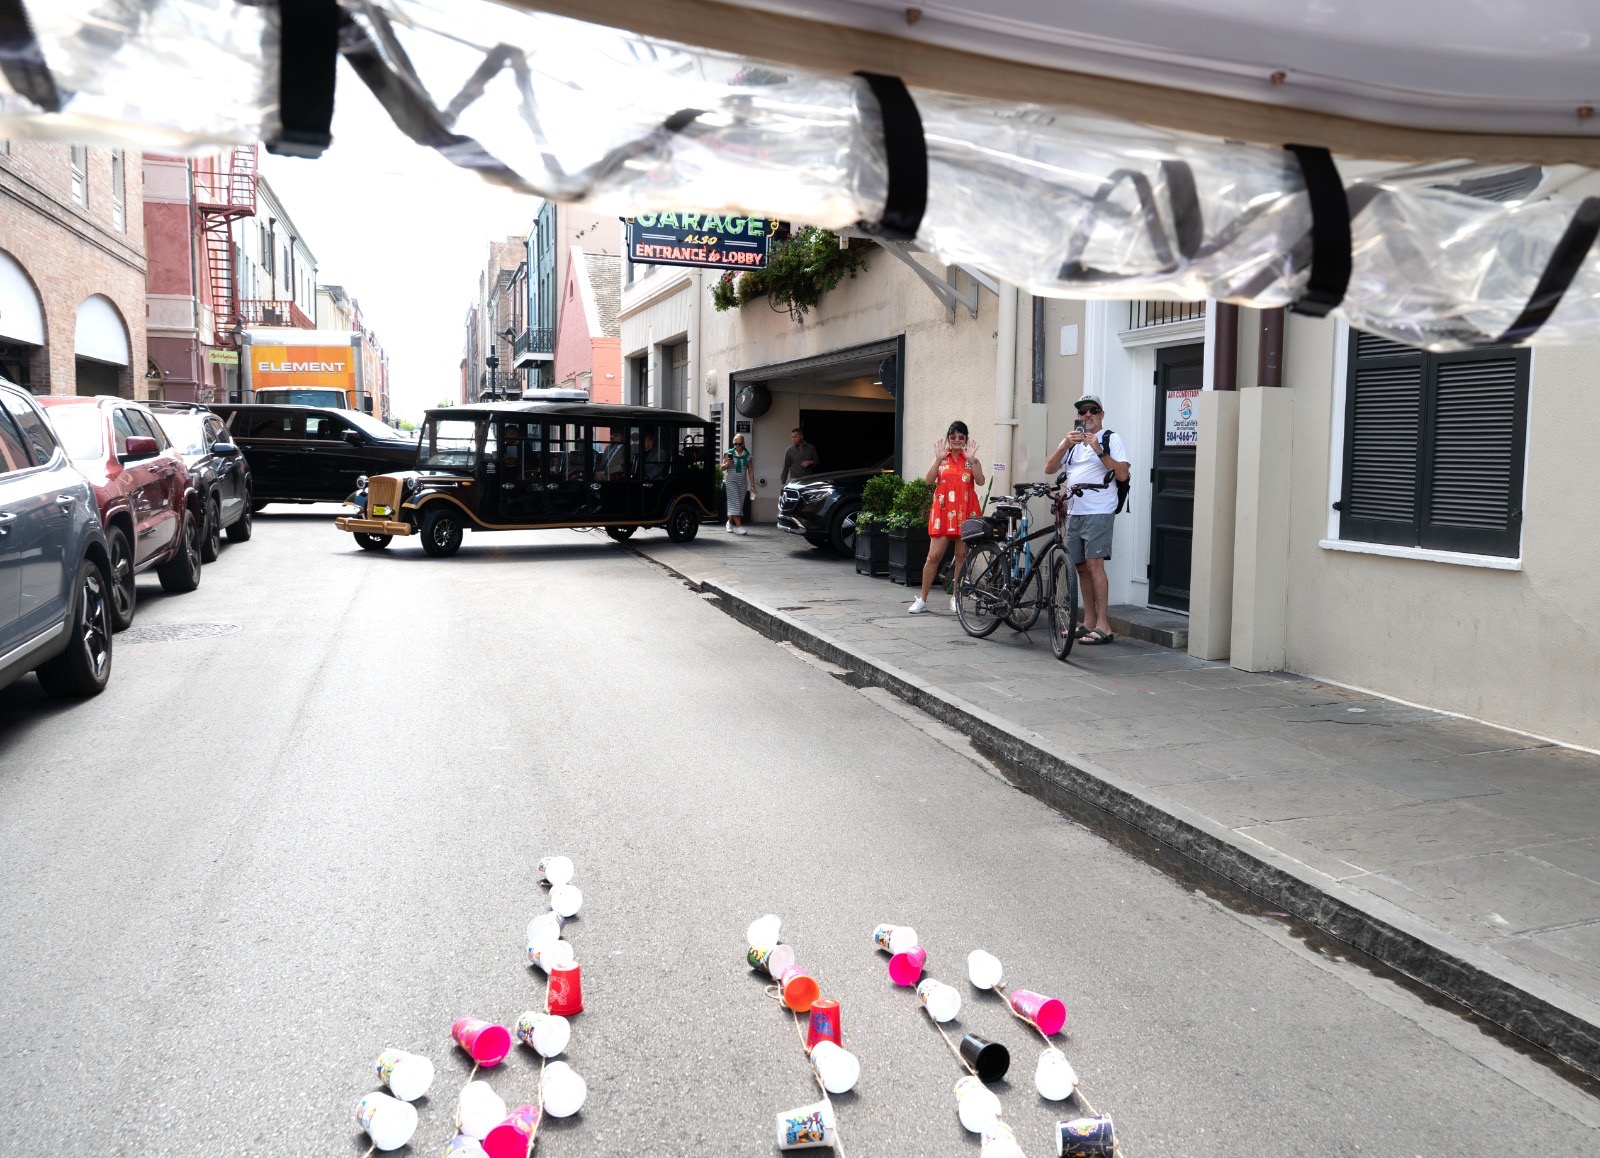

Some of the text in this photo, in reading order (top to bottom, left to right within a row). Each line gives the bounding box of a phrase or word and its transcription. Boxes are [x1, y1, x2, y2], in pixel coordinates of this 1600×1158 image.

[636, 212, 765, 236] GARAGE
[684, 234, 718, 245] ALSO
[636, 243, 763, 265] ENTRANCE to LOBBY
[258, 361, 345, 372] ELEMENT
